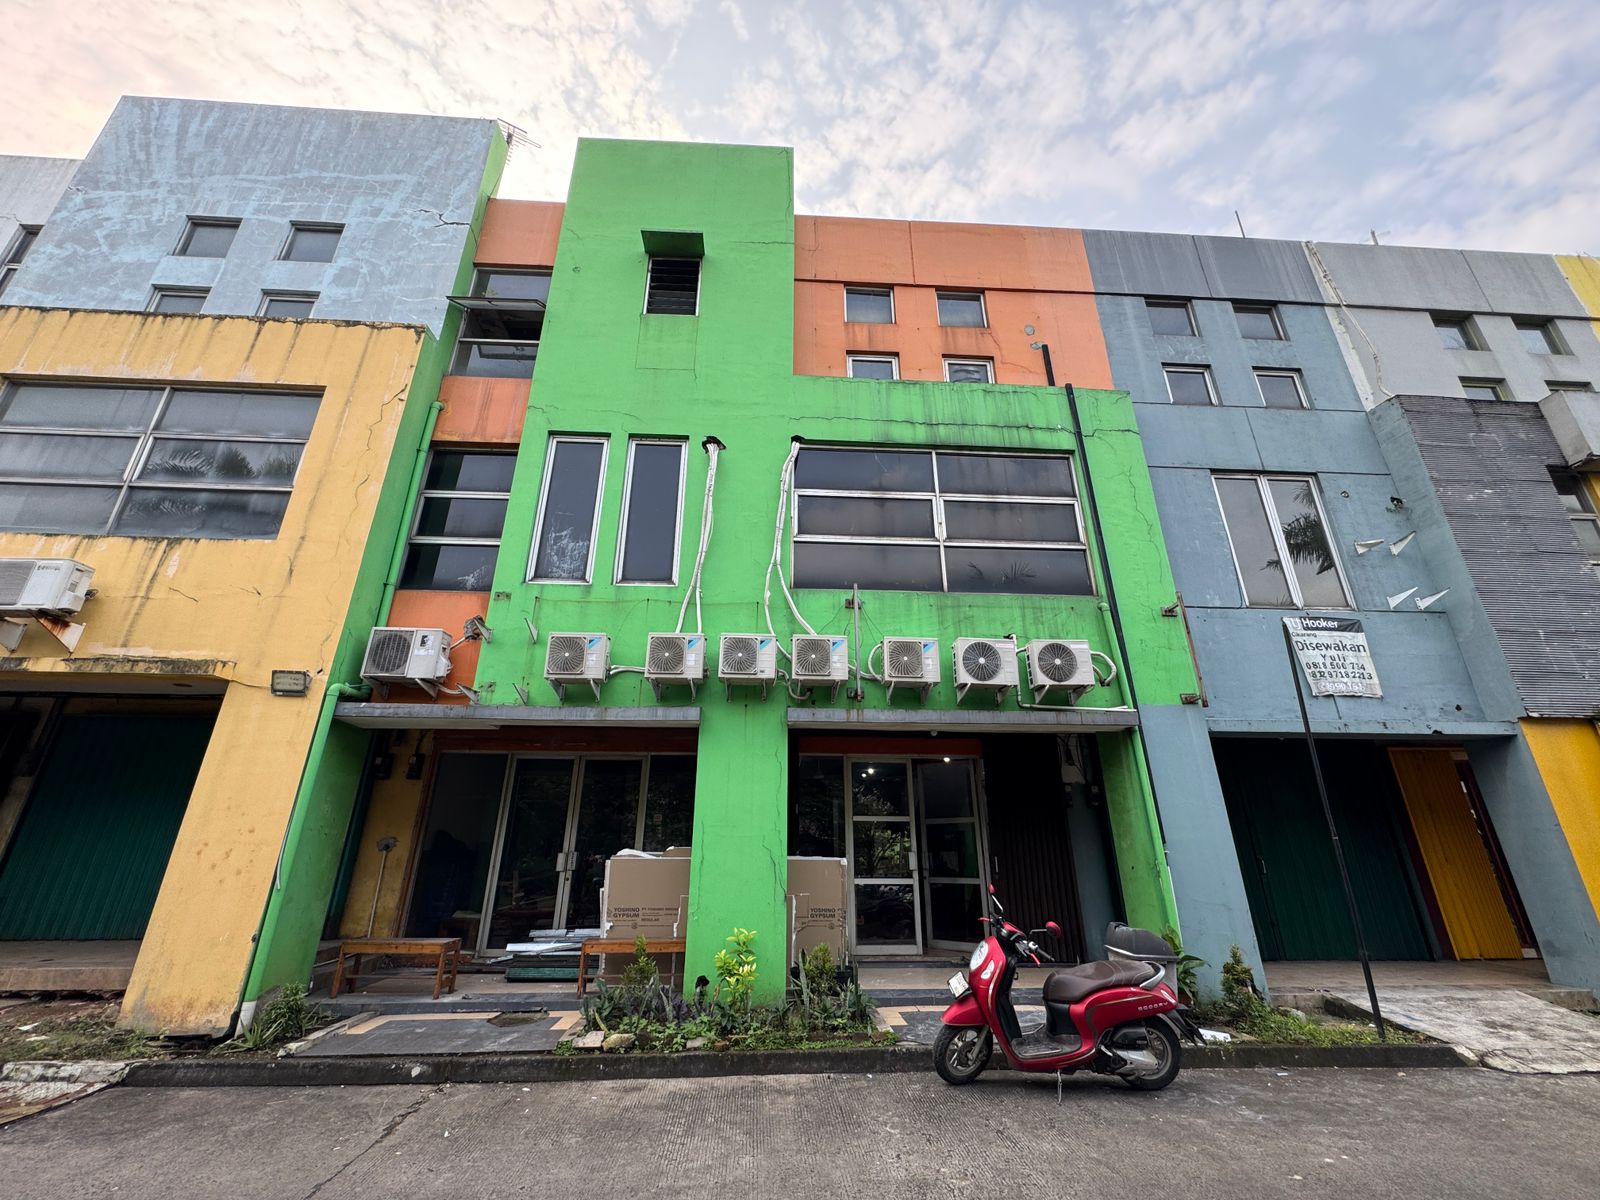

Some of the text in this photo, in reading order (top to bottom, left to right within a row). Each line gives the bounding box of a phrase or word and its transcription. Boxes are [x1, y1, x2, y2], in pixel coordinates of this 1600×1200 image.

[1302, 617, 1339, 629] Hooker
[1295, 640, 1367, 653] Disewakan
[1320, 653, 1347, 663] Yuli
